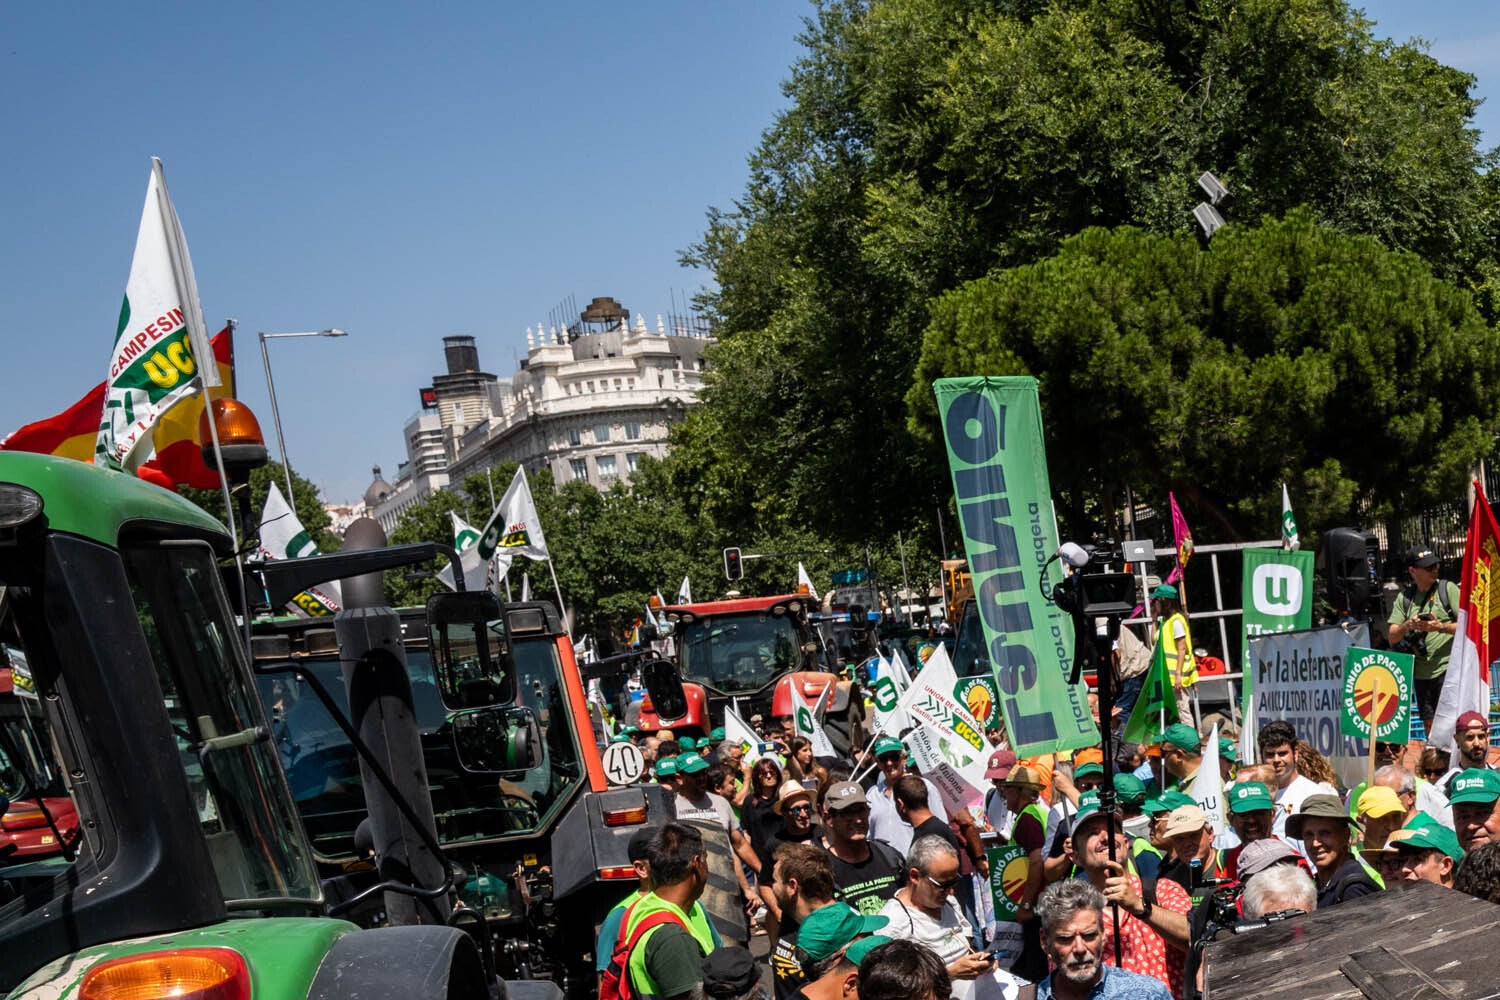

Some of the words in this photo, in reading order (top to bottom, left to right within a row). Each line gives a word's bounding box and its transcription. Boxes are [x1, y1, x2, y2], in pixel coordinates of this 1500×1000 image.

[1276, 651, 1289, 683] la
[1345, 662, 1362, 693] UNIÓ
[1361, 654, 1376, 667] DE
[1376, 654, 1408, 701] PAGESOS
[911, 703, 932, 722] Castilla
[924, 684, 945, 706] UNION
[945, 700, 955, 710] DE
[1344, 697, 1356, 716] DE
[1352, 705, 1408, 737] CATLUNYA
[955, 720, 983, 750] UCCL
[609, 745, 638, 781] 40
[938, 761, 965, 795] Uniones
[993, 859, 1006, 887] UNIÓ
[1004, 848, 1019, 861] DE
[994, 889, 1008, 904] DE
